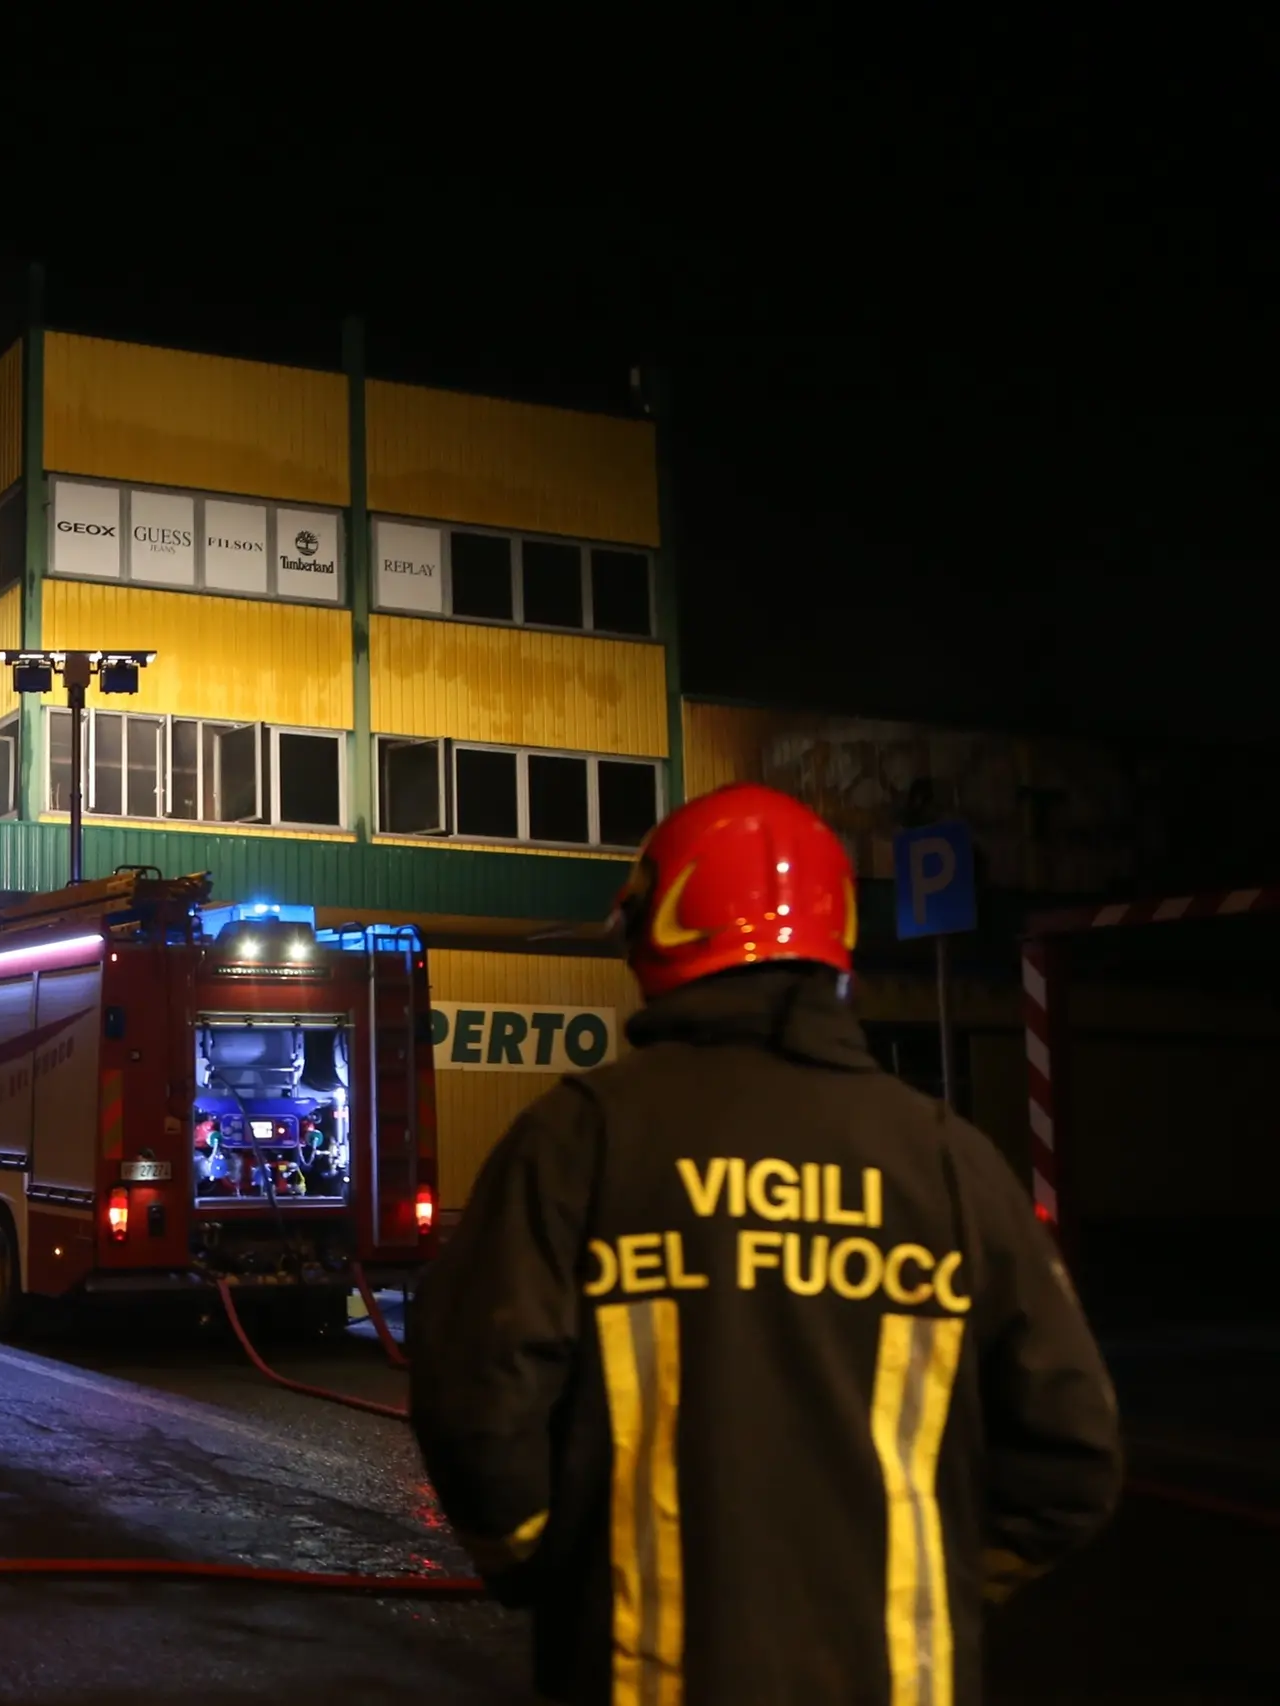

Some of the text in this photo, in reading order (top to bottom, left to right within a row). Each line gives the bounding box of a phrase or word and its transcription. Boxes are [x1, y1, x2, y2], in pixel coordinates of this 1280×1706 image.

[57, 521, 116, 537] GEOX
[134, 526, 192, 547] GUESS
[150, 544, 176, 554] JEANS
[208, 537, 264, 552] FILSON
[280, 556, 334, 574] Timberland
[384, 560, 436, 577] REPLAY
[909, 837, 957, 925] P
[675, 1156, 883, 1229] VIGILI
[582, 1229, 973, 1314] DEL FUOCO
